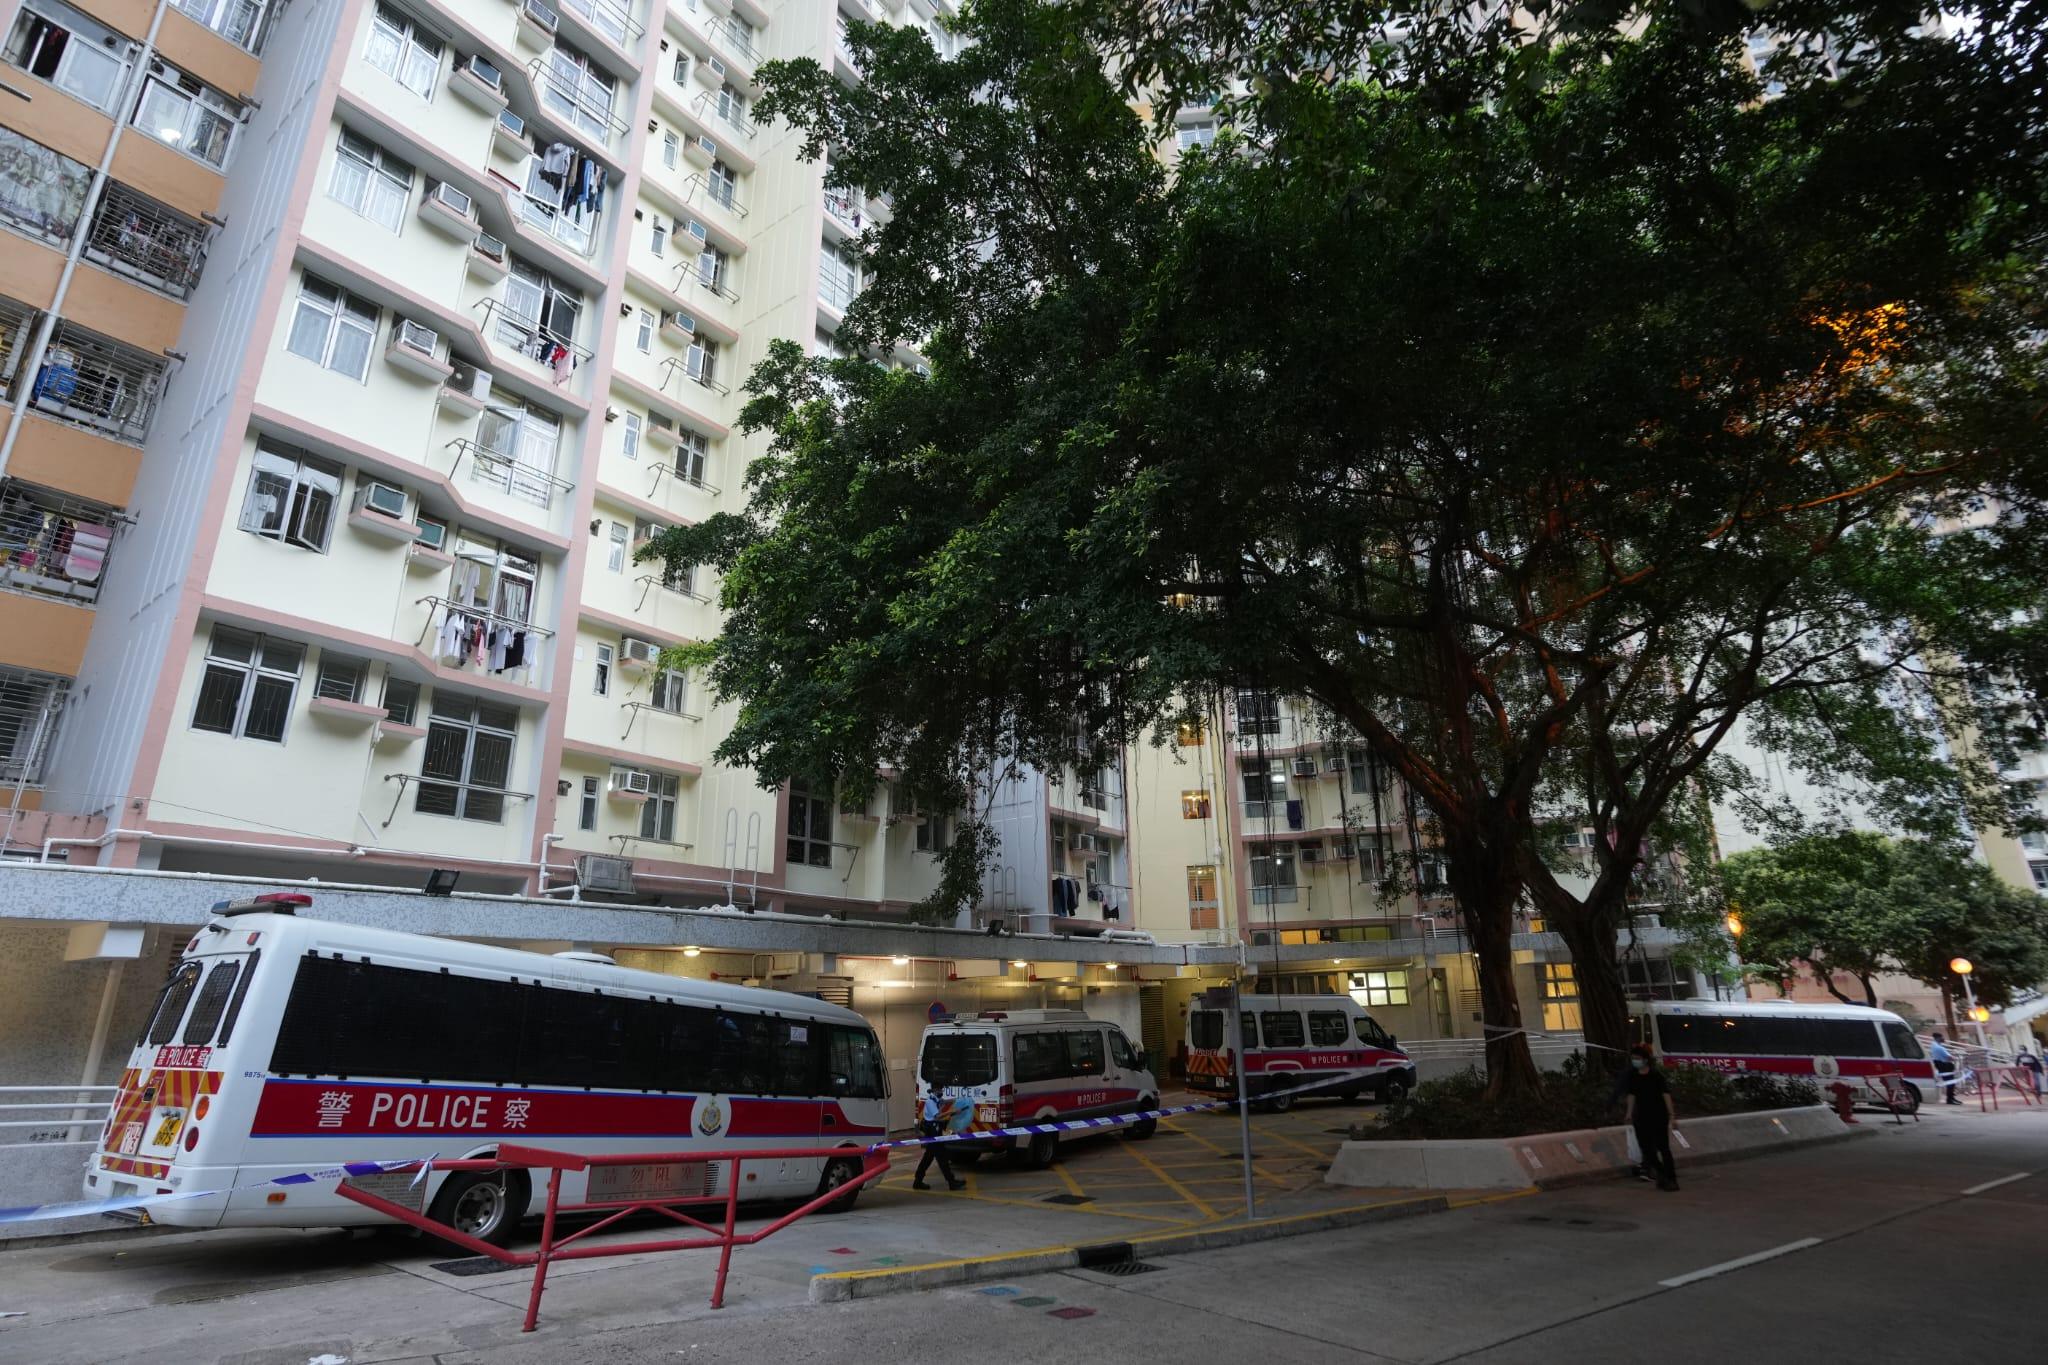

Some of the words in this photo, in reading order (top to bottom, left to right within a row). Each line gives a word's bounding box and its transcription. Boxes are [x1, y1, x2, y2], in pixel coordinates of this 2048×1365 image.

[166, 1048, 197, 1066] POLICE
[1318, 1056, 1341, 1064] POLICE
[316, 1091, 354, 1127] 警
[368, 1093, 492, 1127] POLICE
[503, 1098, 531, 1129] 察
